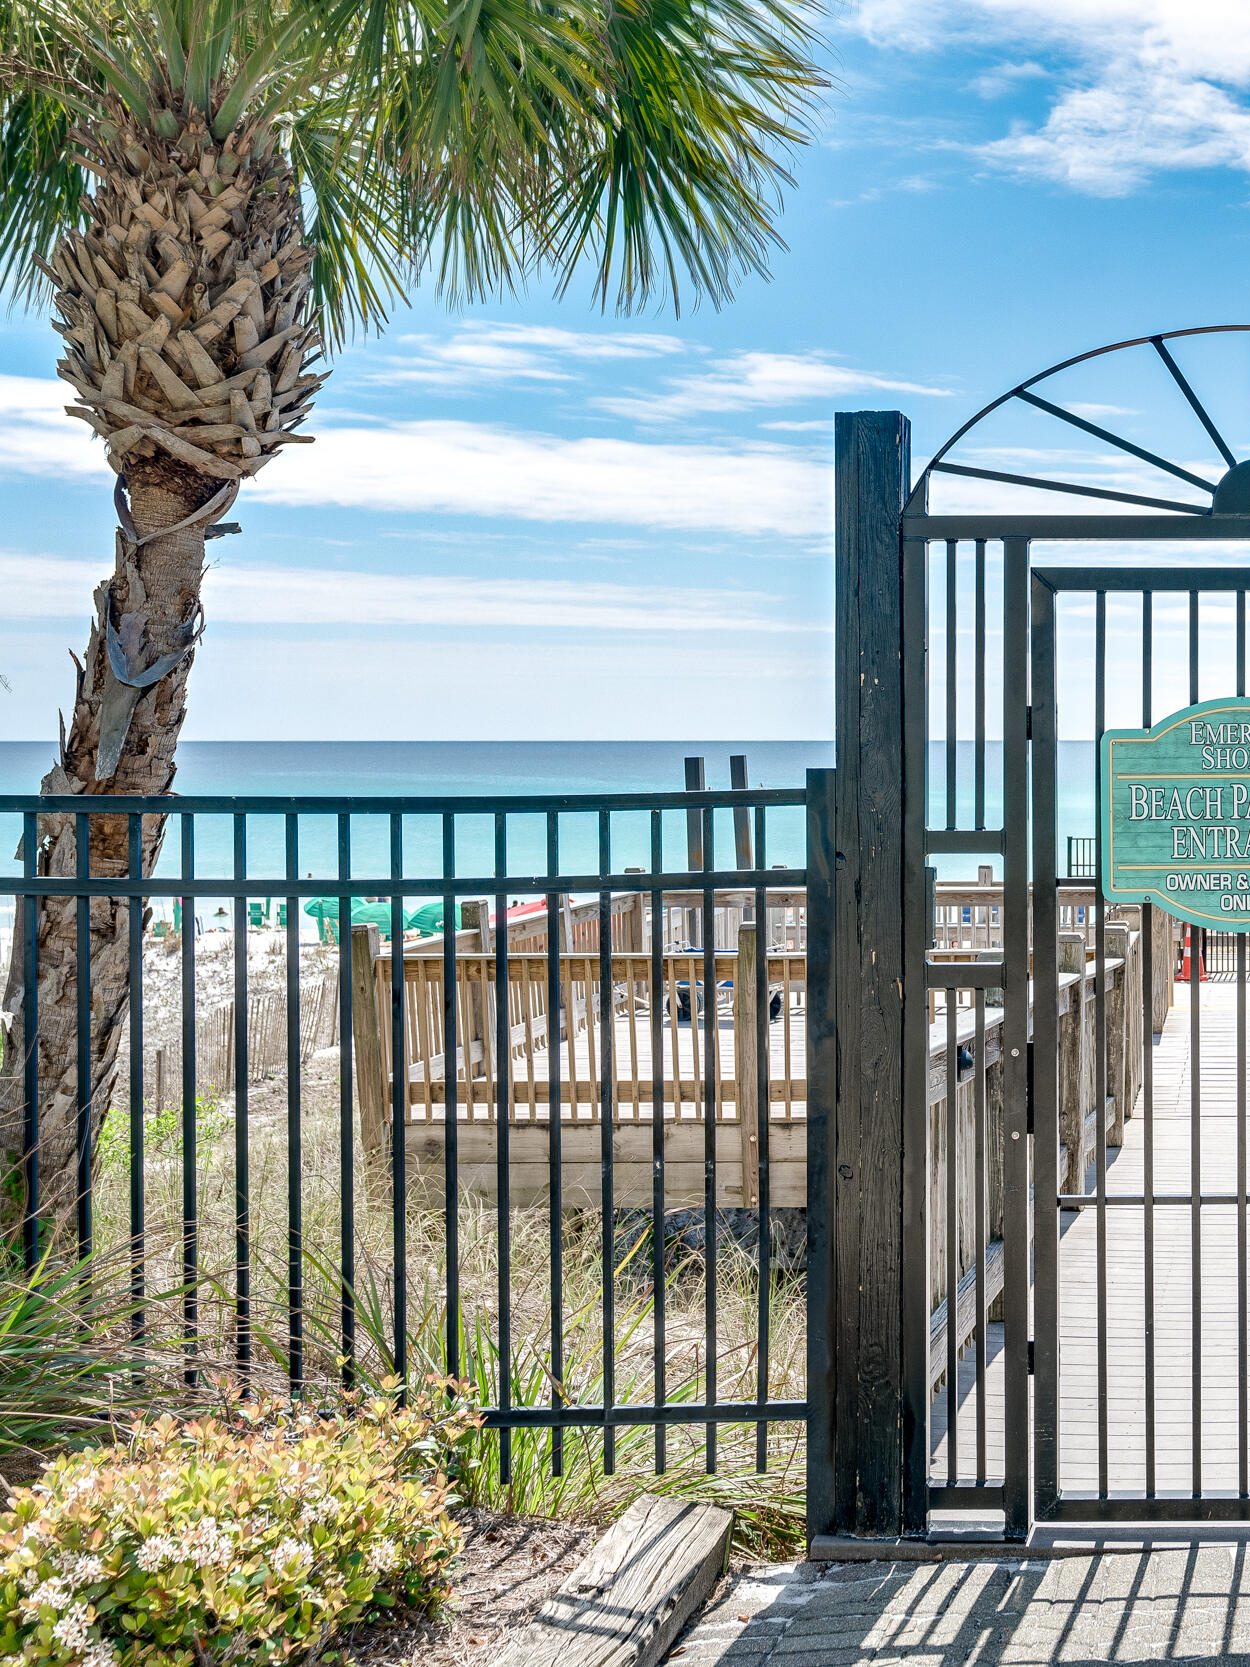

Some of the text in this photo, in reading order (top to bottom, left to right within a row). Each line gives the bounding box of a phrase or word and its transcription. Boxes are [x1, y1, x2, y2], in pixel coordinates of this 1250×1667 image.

[1128, 784, 1224, 821] BEACH
[1166, 874, 1232, 891] OWNER
[1236, 874, 1250, 890] &
